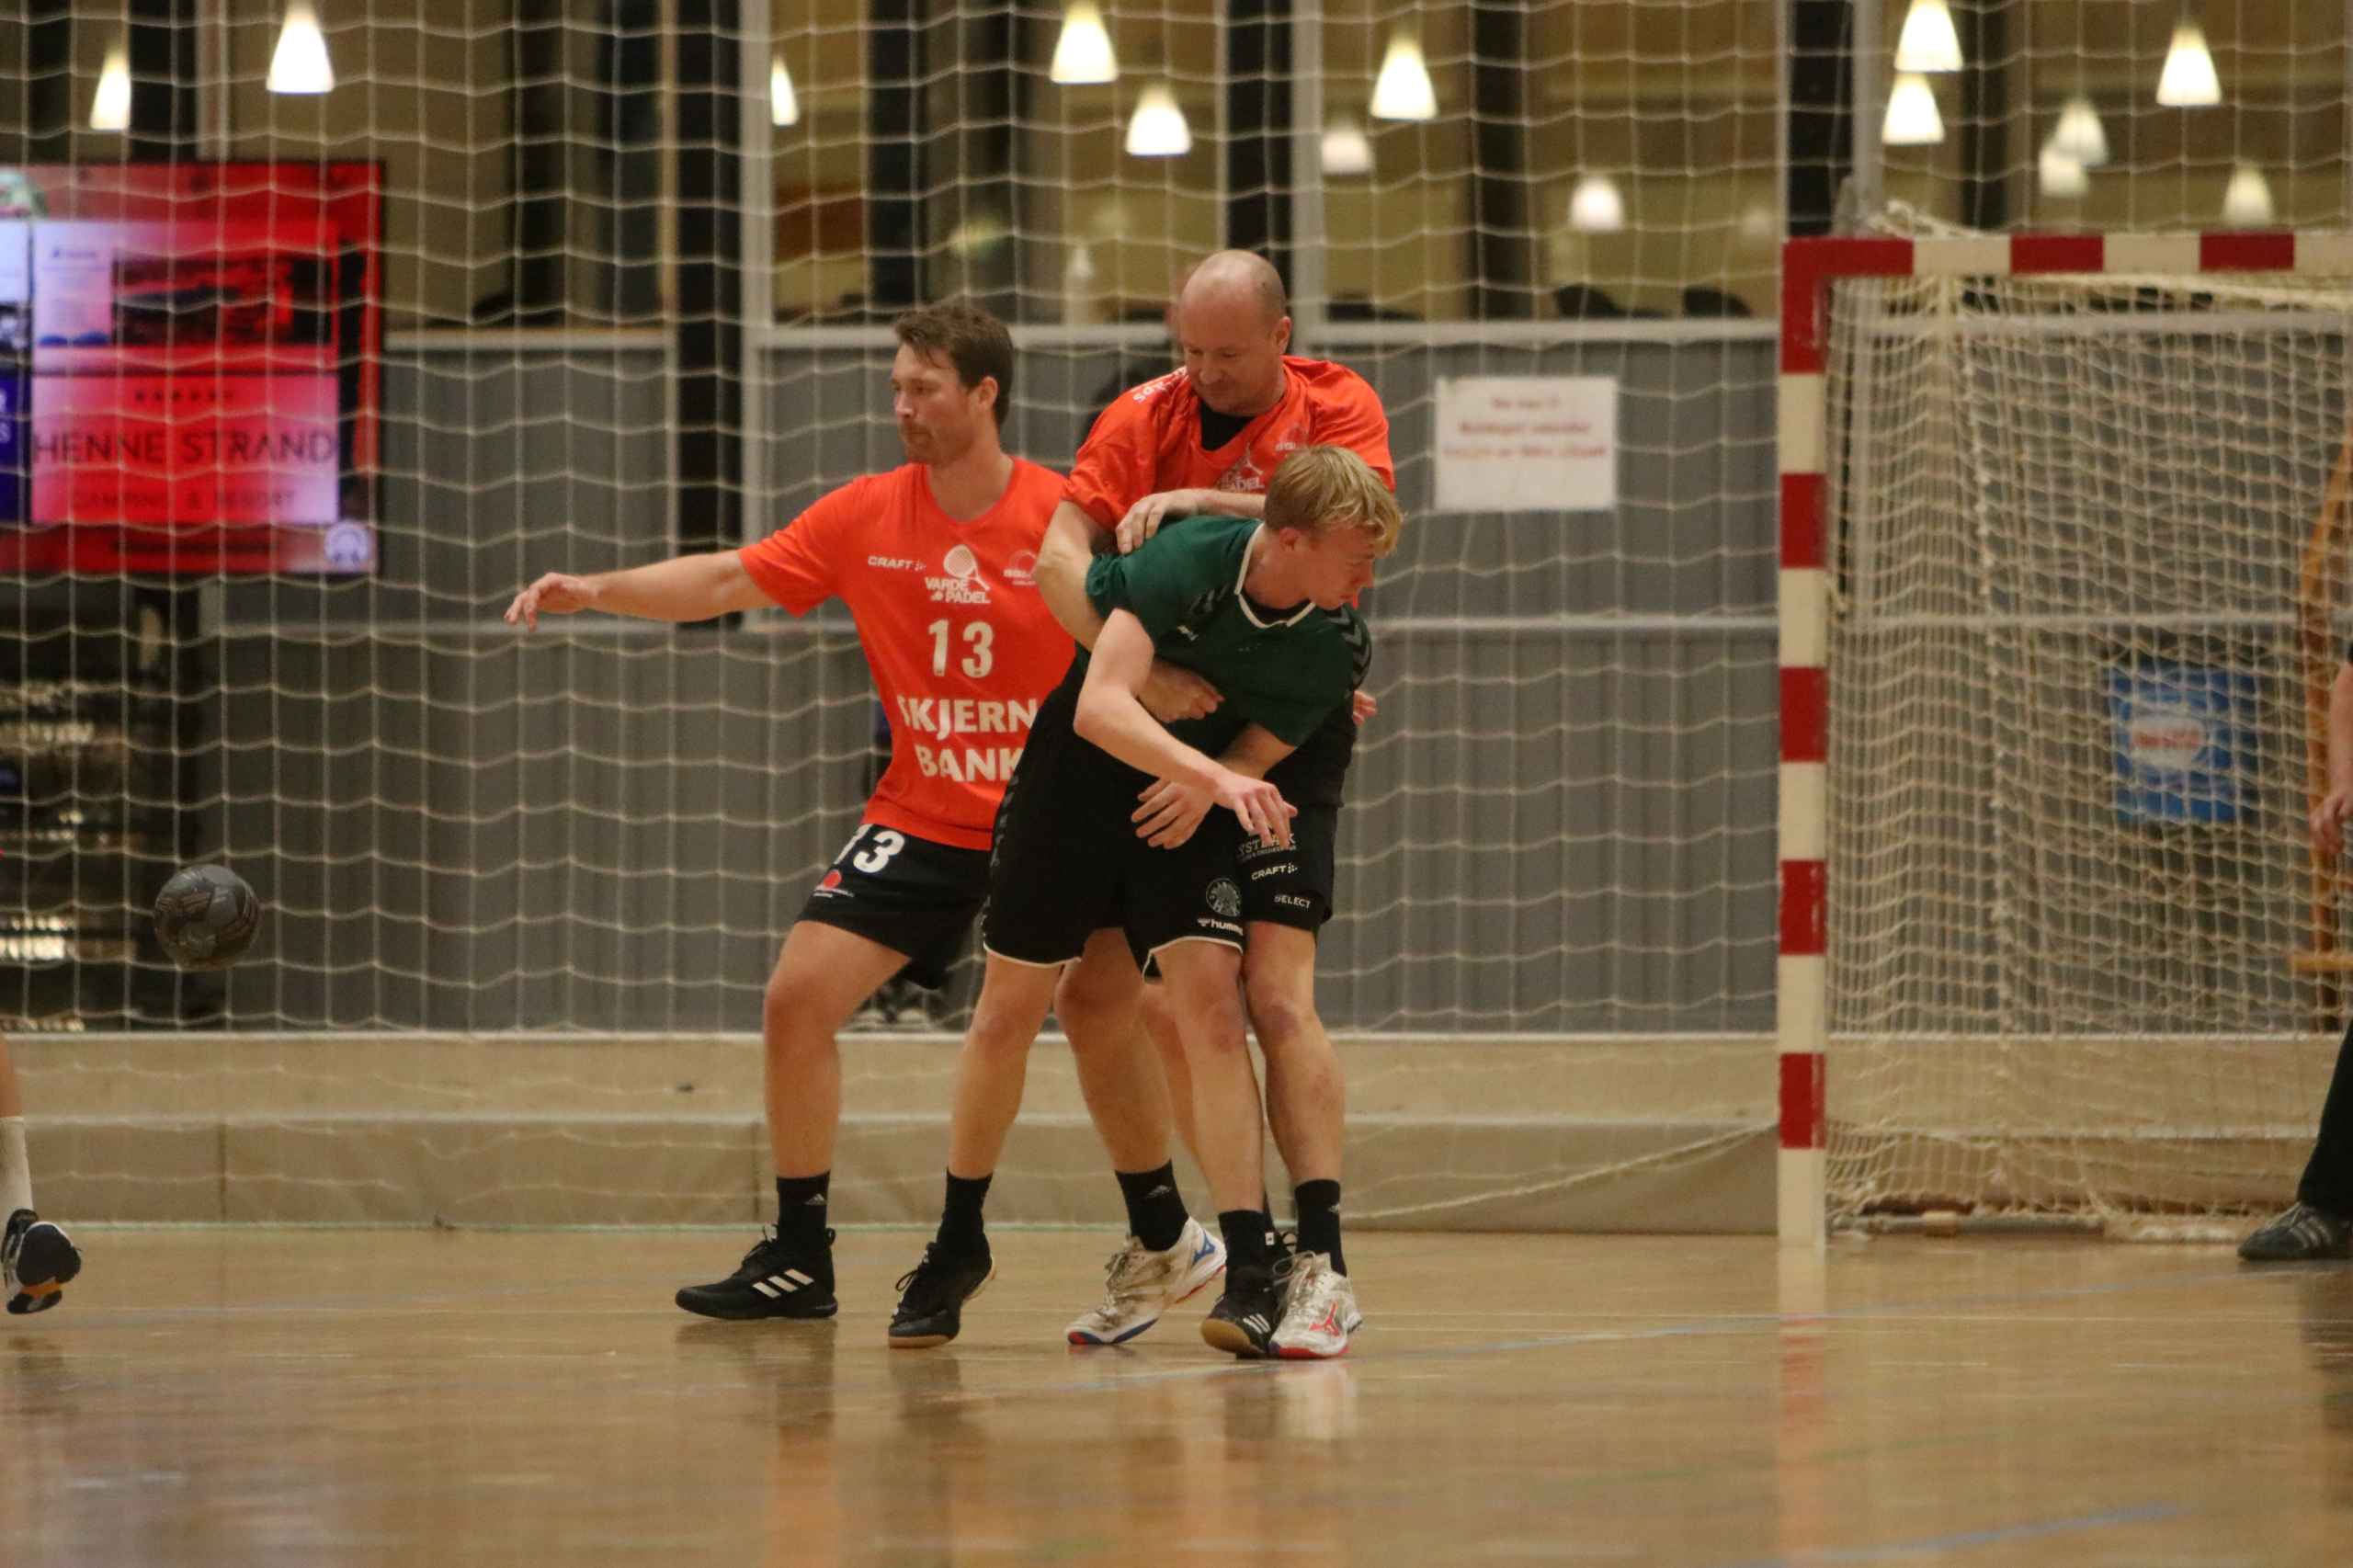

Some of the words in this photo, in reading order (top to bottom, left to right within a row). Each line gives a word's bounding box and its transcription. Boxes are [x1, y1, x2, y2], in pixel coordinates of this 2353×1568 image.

[34, 430, 166, 462] HENNE
[185, 429, 336, 462] STRAND
[867, 555, 913, 570] CRAFT
[945, 590, 991, 603] PADEL
[927, 619, 995, 678] 13
[914, 744, 1025, 782] BANK
[1251, 865, 1287, 881] CRAFT
[1274, 894, 1311, 909] SELECT
